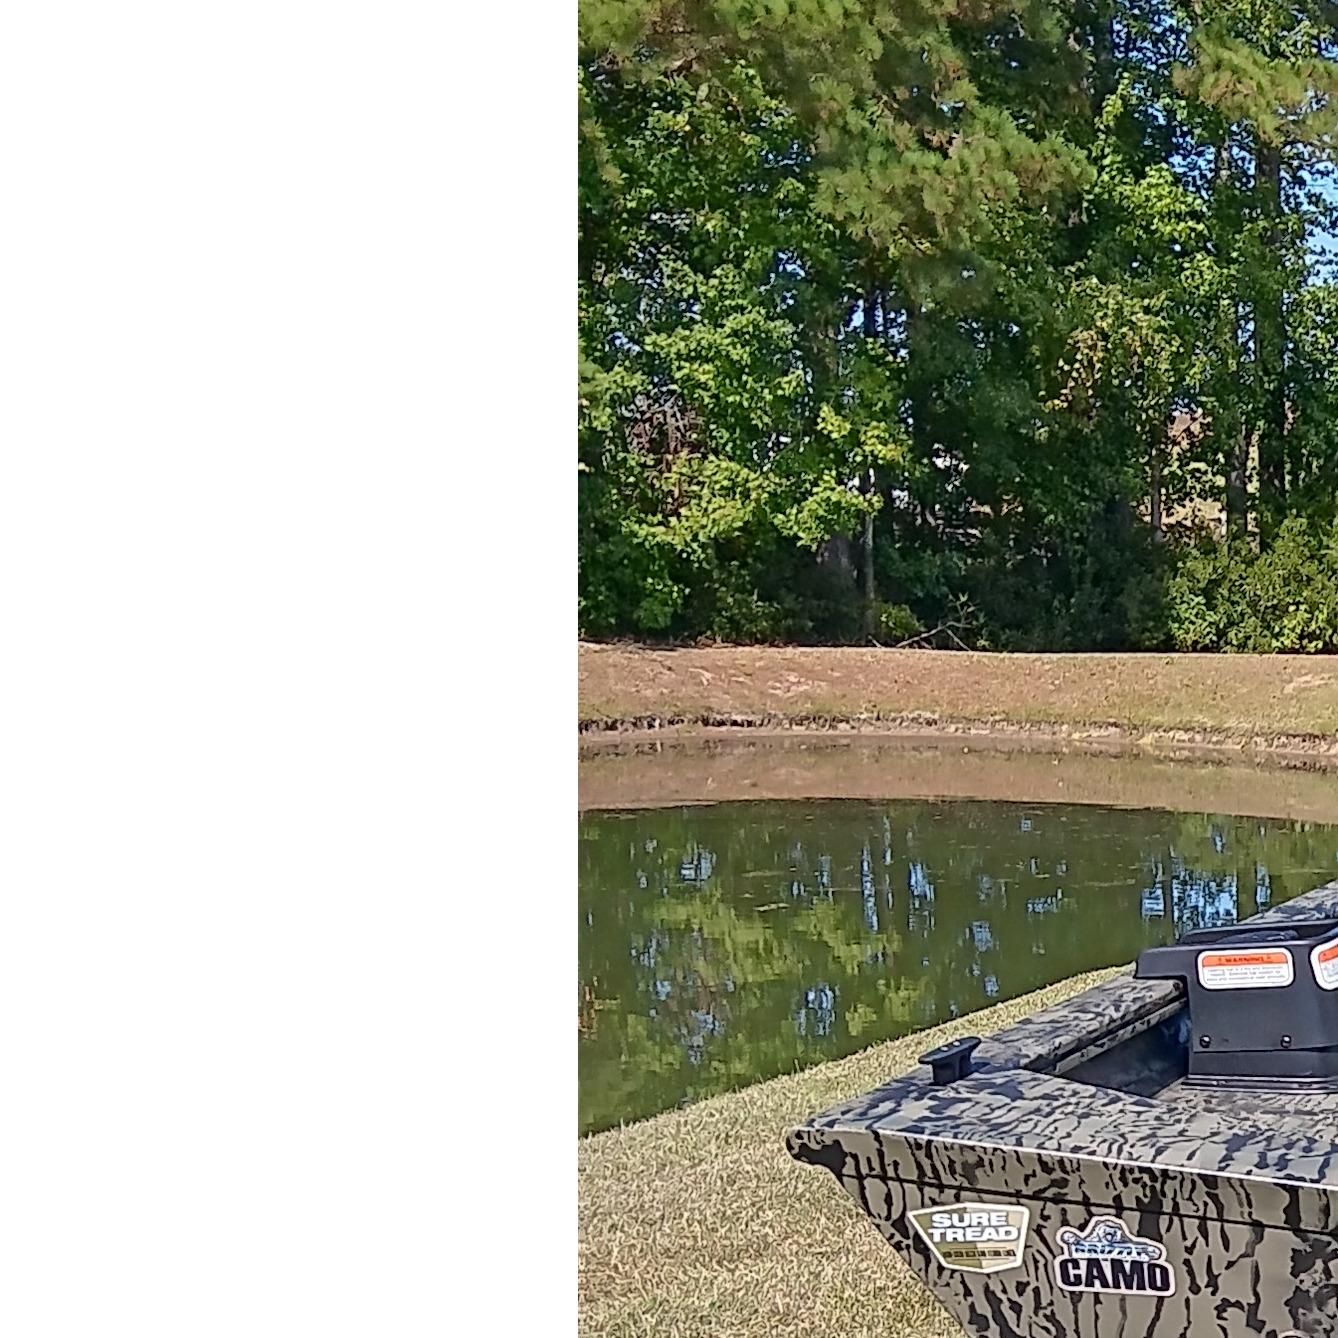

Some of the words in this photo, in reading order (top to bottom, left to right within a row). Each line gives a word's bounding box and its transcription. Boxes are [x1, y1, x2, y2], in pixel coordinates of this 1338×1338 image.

[931, 1211, 1008, 1228] SURE
[928, 1226, 1019, 1243] TREAD
[1060, 1258, 1171, 1291] CAMO
